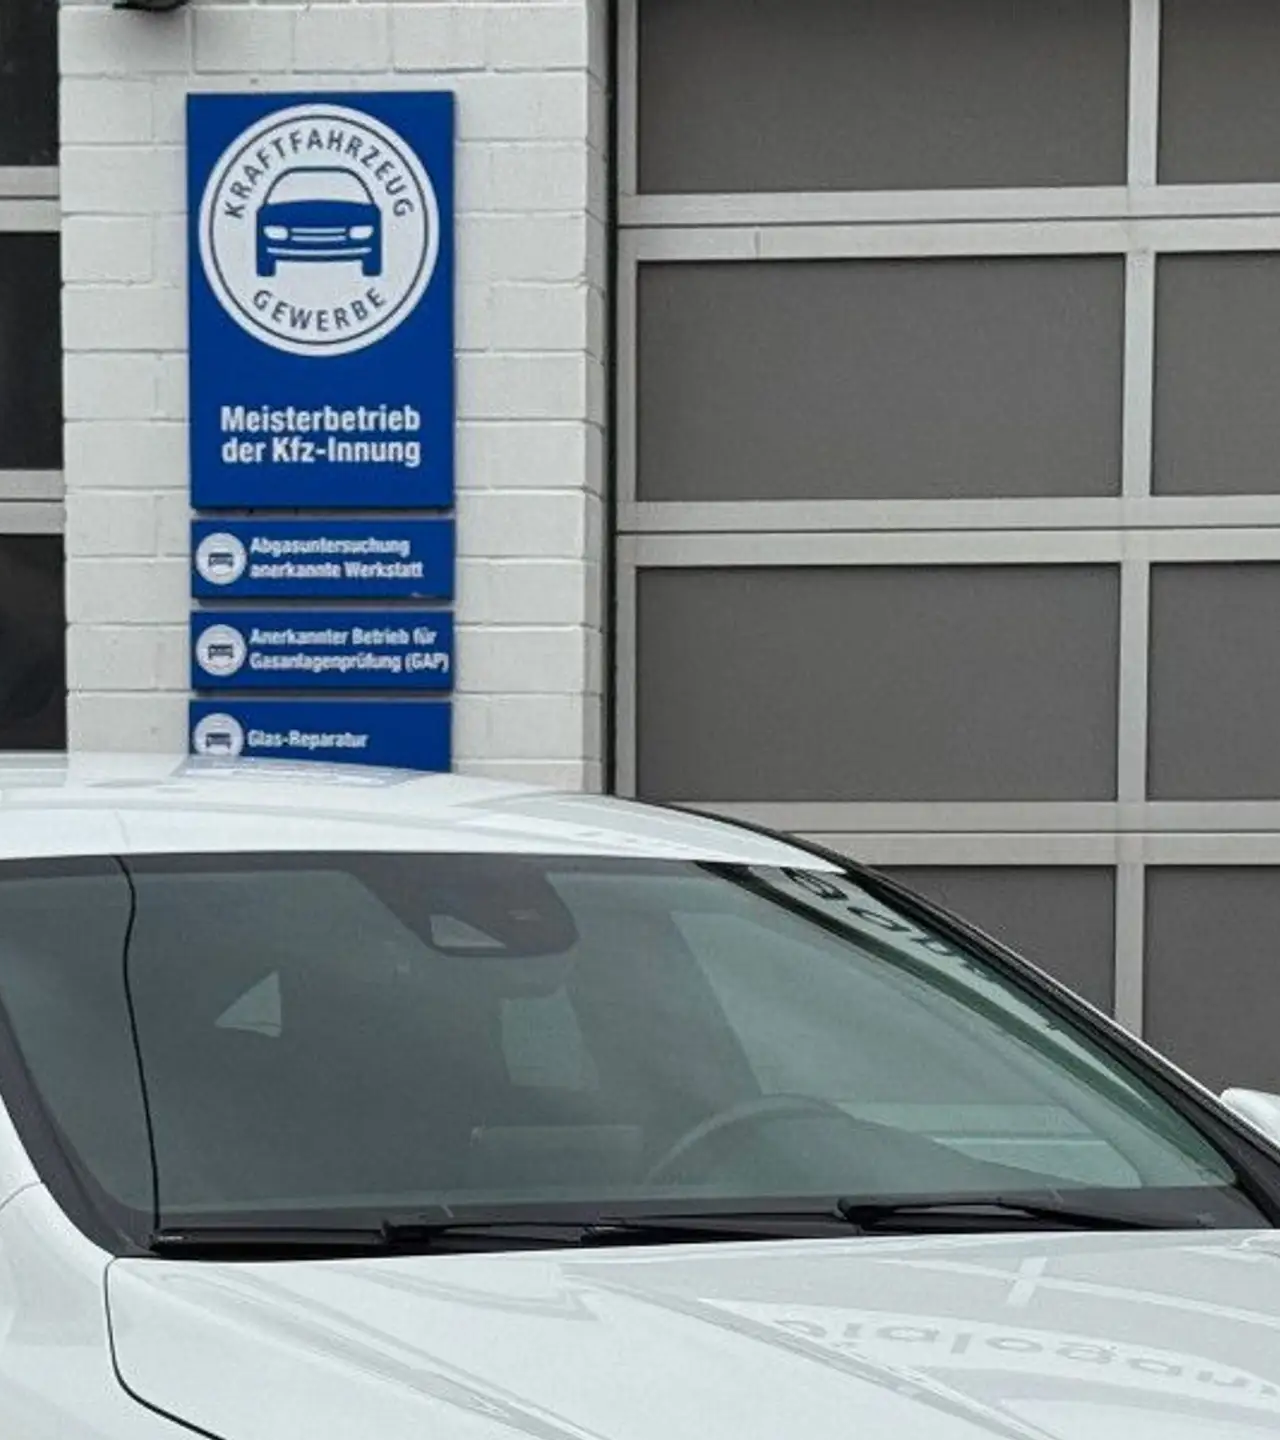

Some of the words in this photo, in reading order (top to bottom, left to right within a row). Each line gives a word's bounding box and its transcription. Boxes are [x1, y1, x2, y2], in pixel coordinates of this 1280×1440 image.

[223, 128, 415, 219] KRAFTFAHRZEUG
[252, 287, 387, 332] GEWERBE
[220, 405, 421, 432] Meisterbetrieb
[221, 437, 266, 464] der
[272, 437, 422, 468] Kfz-Innung
[249, 536, 411, 558] Abgasuntersuchung
[249, 561, 341, 578] anerkannte
[342, 560, 424, 578] Werkstatt
[249, 628, 349, 646] Anerkannter
[351, 627, 410, 646] Betrieb
[412, 626, 438, 646] für
[249, 651, 403, 673] Gasanlagenprüfung
[404, 652, 450, 674] (GAP)
[247, 729, 370, 750] Glas-Reparatur
